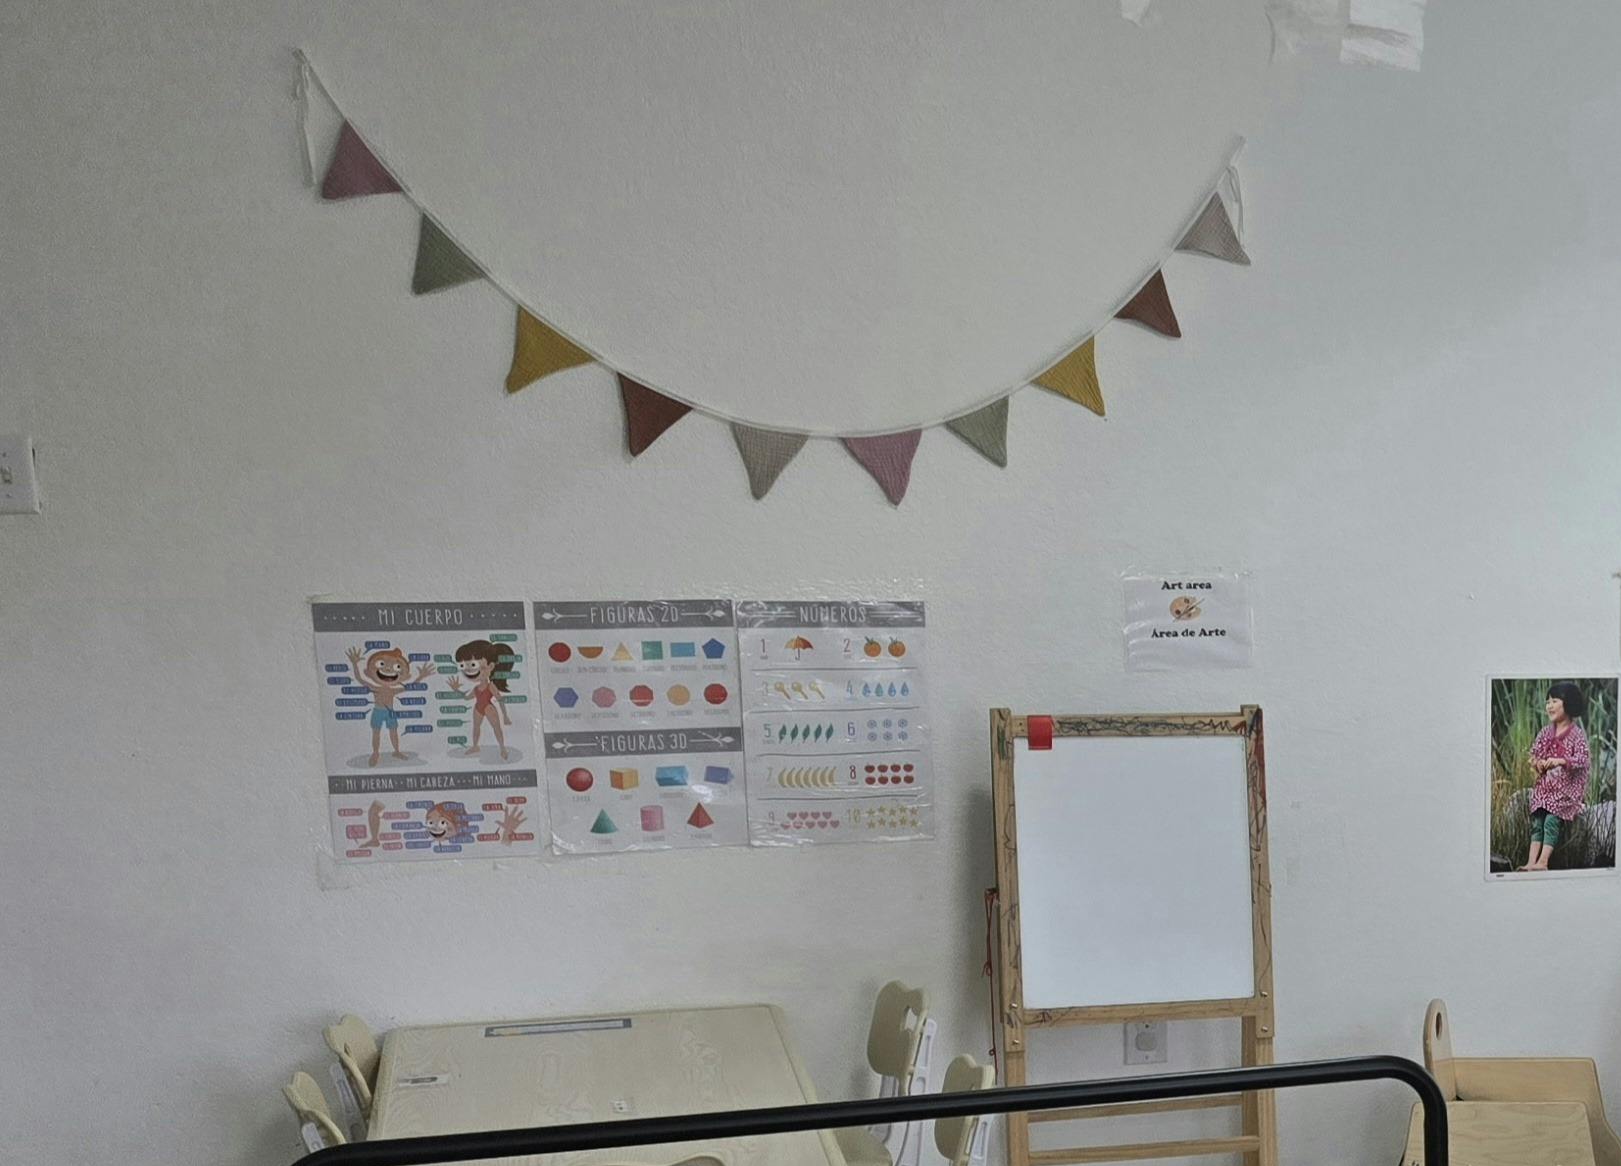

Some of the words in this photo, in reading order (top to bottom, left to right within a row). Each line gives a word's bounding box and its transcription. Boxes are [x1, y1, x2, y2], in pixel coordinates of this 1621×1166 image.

[1161, 581, 1183, 590] Art
[378, 609, 395, 625] MI
[405, 608, 463, 626] CUERPO
[590, 606, 655, 624] FIGURAS
[661, 606, 679, 623] 2D
[1181, 629, 1195, 637] de
[1199, 628, 1226, 637] Arte
[763, 724, 771, 737] 5
[601, 733, 665, 752] FIGURAS
[670, 733, 688, 749] 3D
[850, 765, 857, 779] 8
[346, 779, 357, 791] MI
[361, 778, 394, 790] PIERNA
[406, 777, 417, 788] MI
[420, 776, 456, 788] CABEZA
[473, 775, 483, 785] MI
[487, 774, 511, 785] MANO
